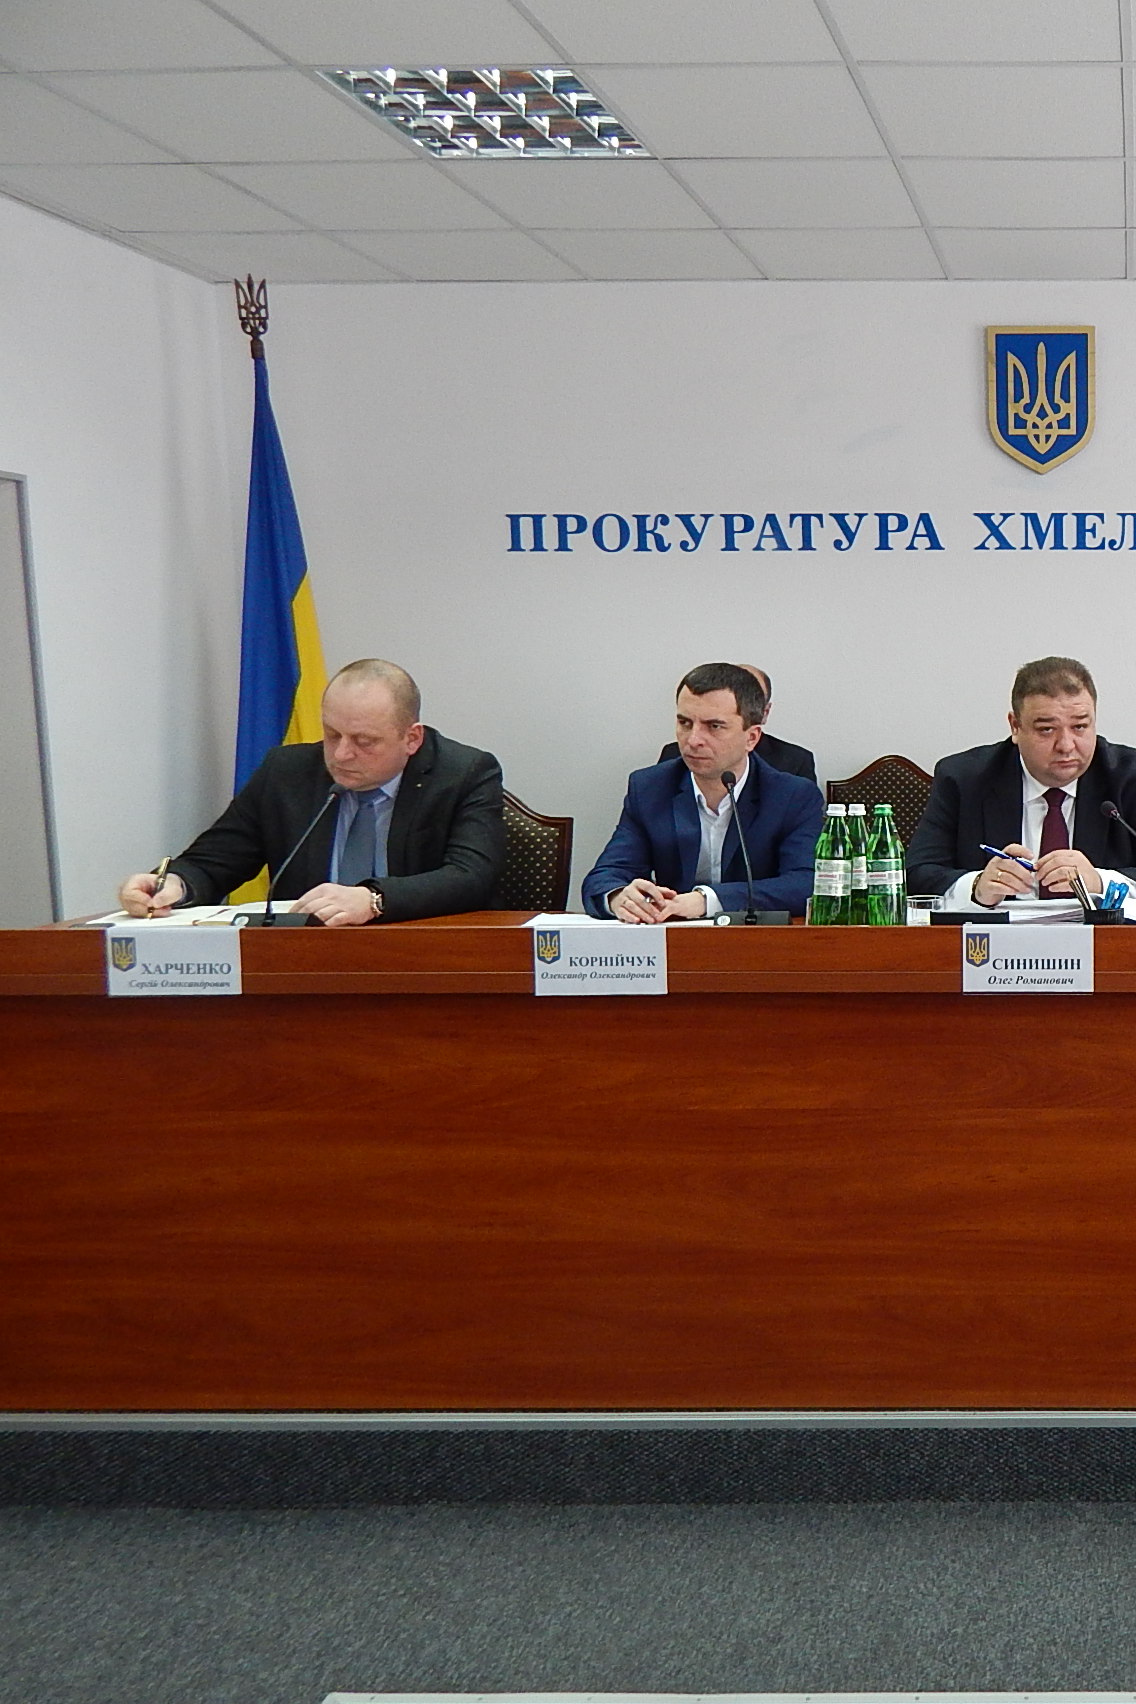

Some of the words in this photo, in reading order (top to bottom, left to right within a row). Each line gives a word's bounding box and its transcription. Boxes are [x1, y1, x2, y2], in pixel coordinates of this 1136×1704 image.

[505, 512, 945, 553] ПРОКУРАТУРА
[569, 954, 656, 967] КОРНІЙЧУК
[992, 958, 1081, 970] СИНИШИН
[141, 962, 232, 975] ХАРЧЕНКО
[987, 975, 1013, 985] Олег
[1015, 975, 1074, 985] Романович
